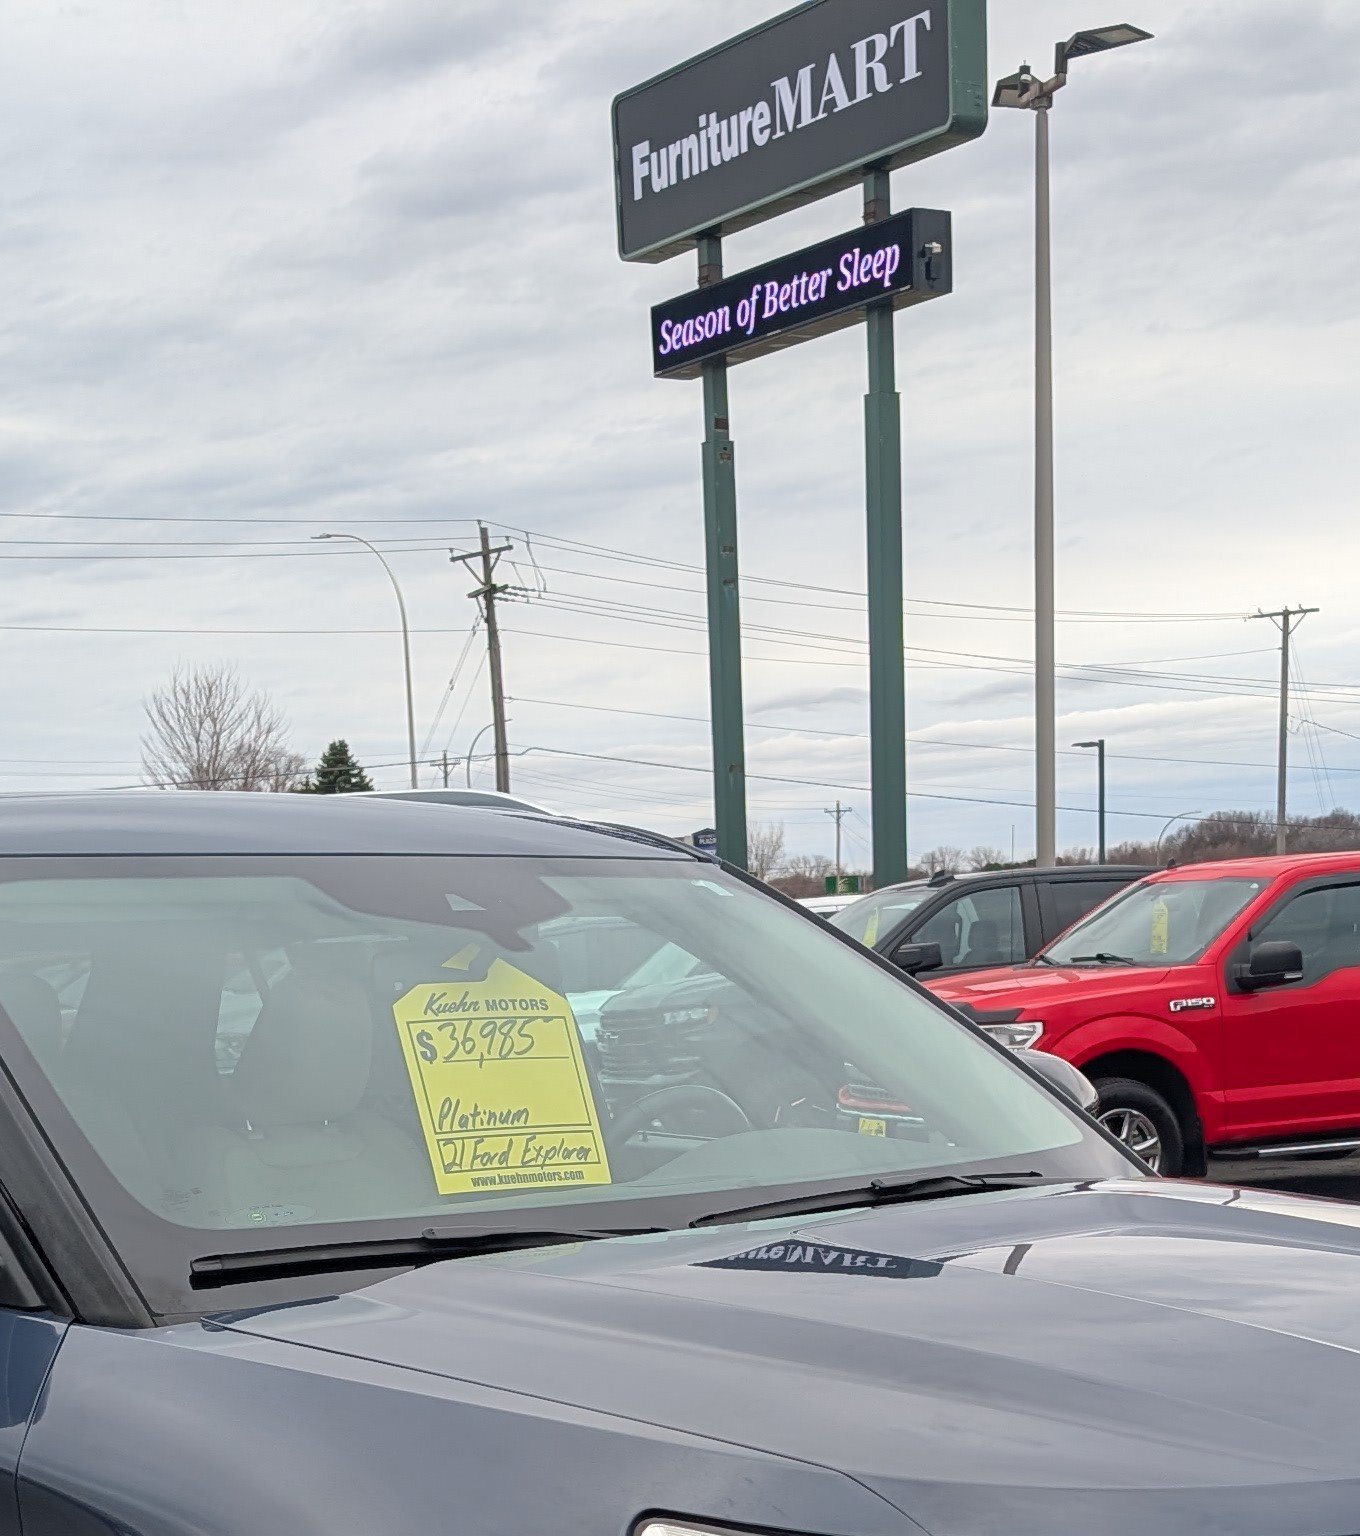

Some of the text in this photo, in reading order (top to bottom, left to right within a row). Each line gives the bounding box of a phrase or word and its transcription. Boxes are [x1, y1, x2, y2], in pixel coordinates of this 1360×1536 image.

[658, 243, 900, 356] Season of Better Sleep
[423, 991, 549, 1018] Kuehn MOTORS
[438, 1096, 530, 1131] Platinum
[441, 1134, 592, 1171] 21 Ford Explorer
[470, 1169, 585, 1188] www.kuehnmotors.com
